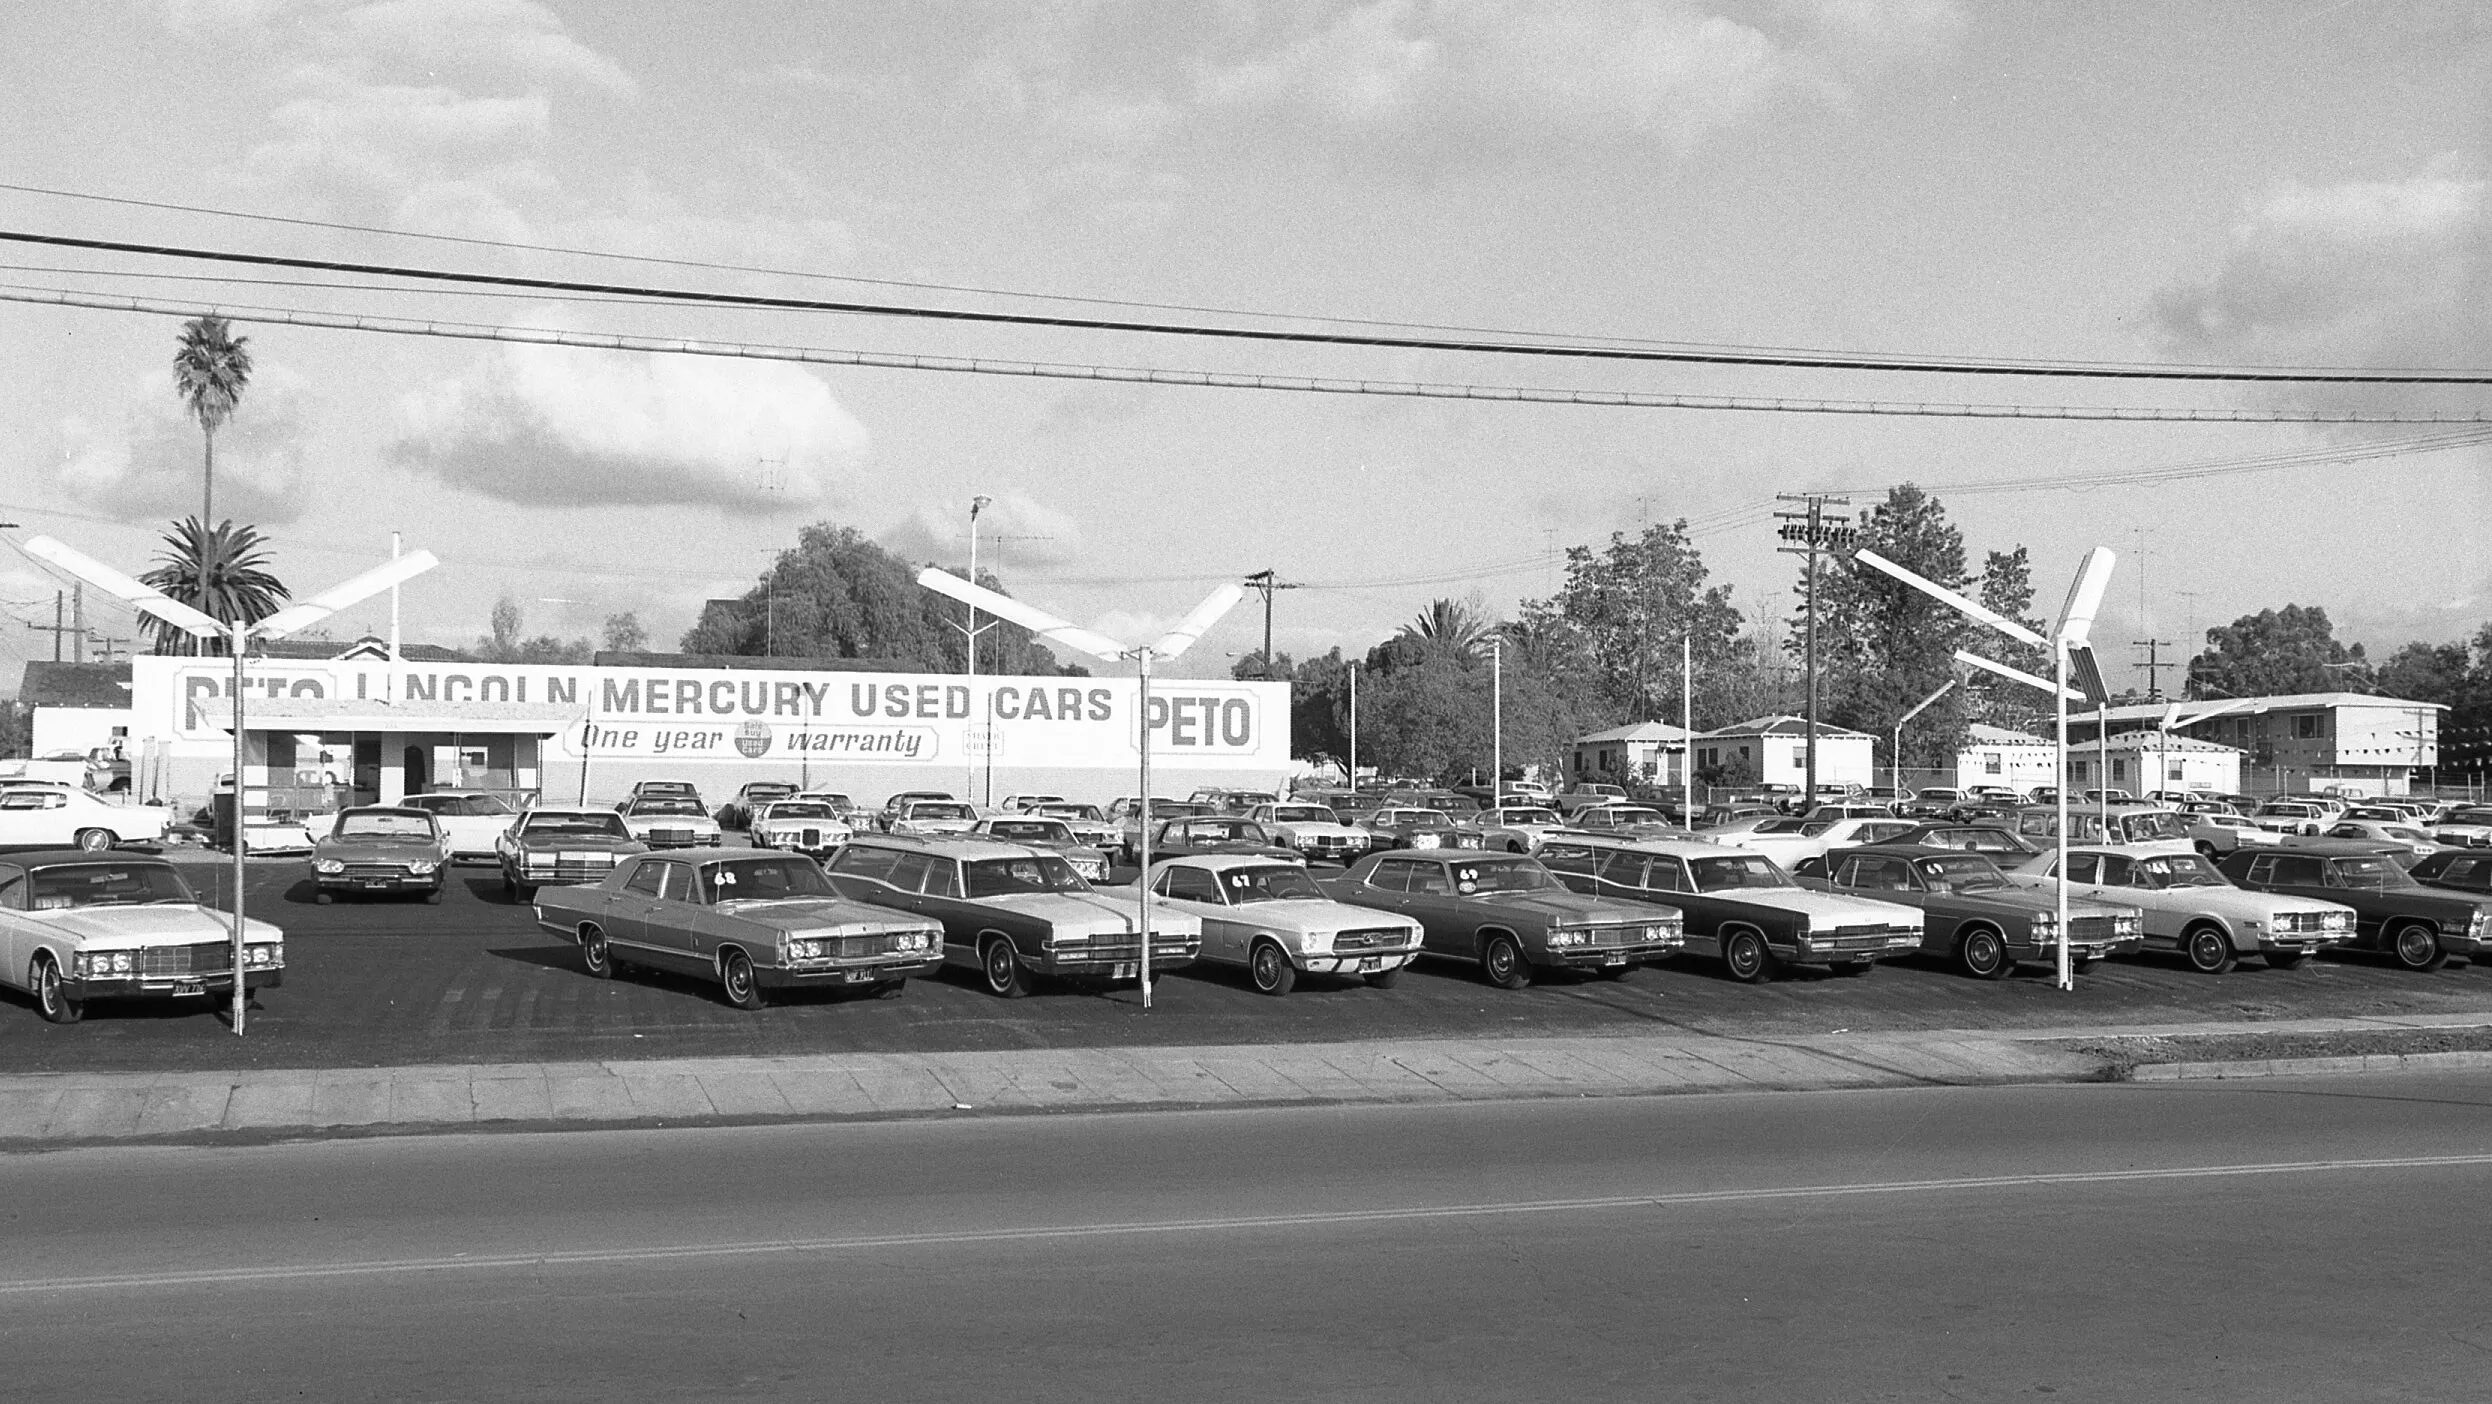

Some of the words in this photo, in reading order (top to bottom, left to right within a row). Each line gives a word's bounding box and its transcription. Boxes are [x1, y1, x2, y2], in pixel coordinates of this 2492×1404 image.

[357, 672, 577, 703] LNCOLN
[602, 677, 831, 716] MERCURY
[851, 683, 970, 719] USED
[995, 686, 1112, 721] CARS
[580, 724, 639, 749] One
[652, 730, 723, 754] year
[787, 730, 922, 757] warranty
[1149, 696, 1251, 746] PETO
[1460, 868, 1478, 880] 69
